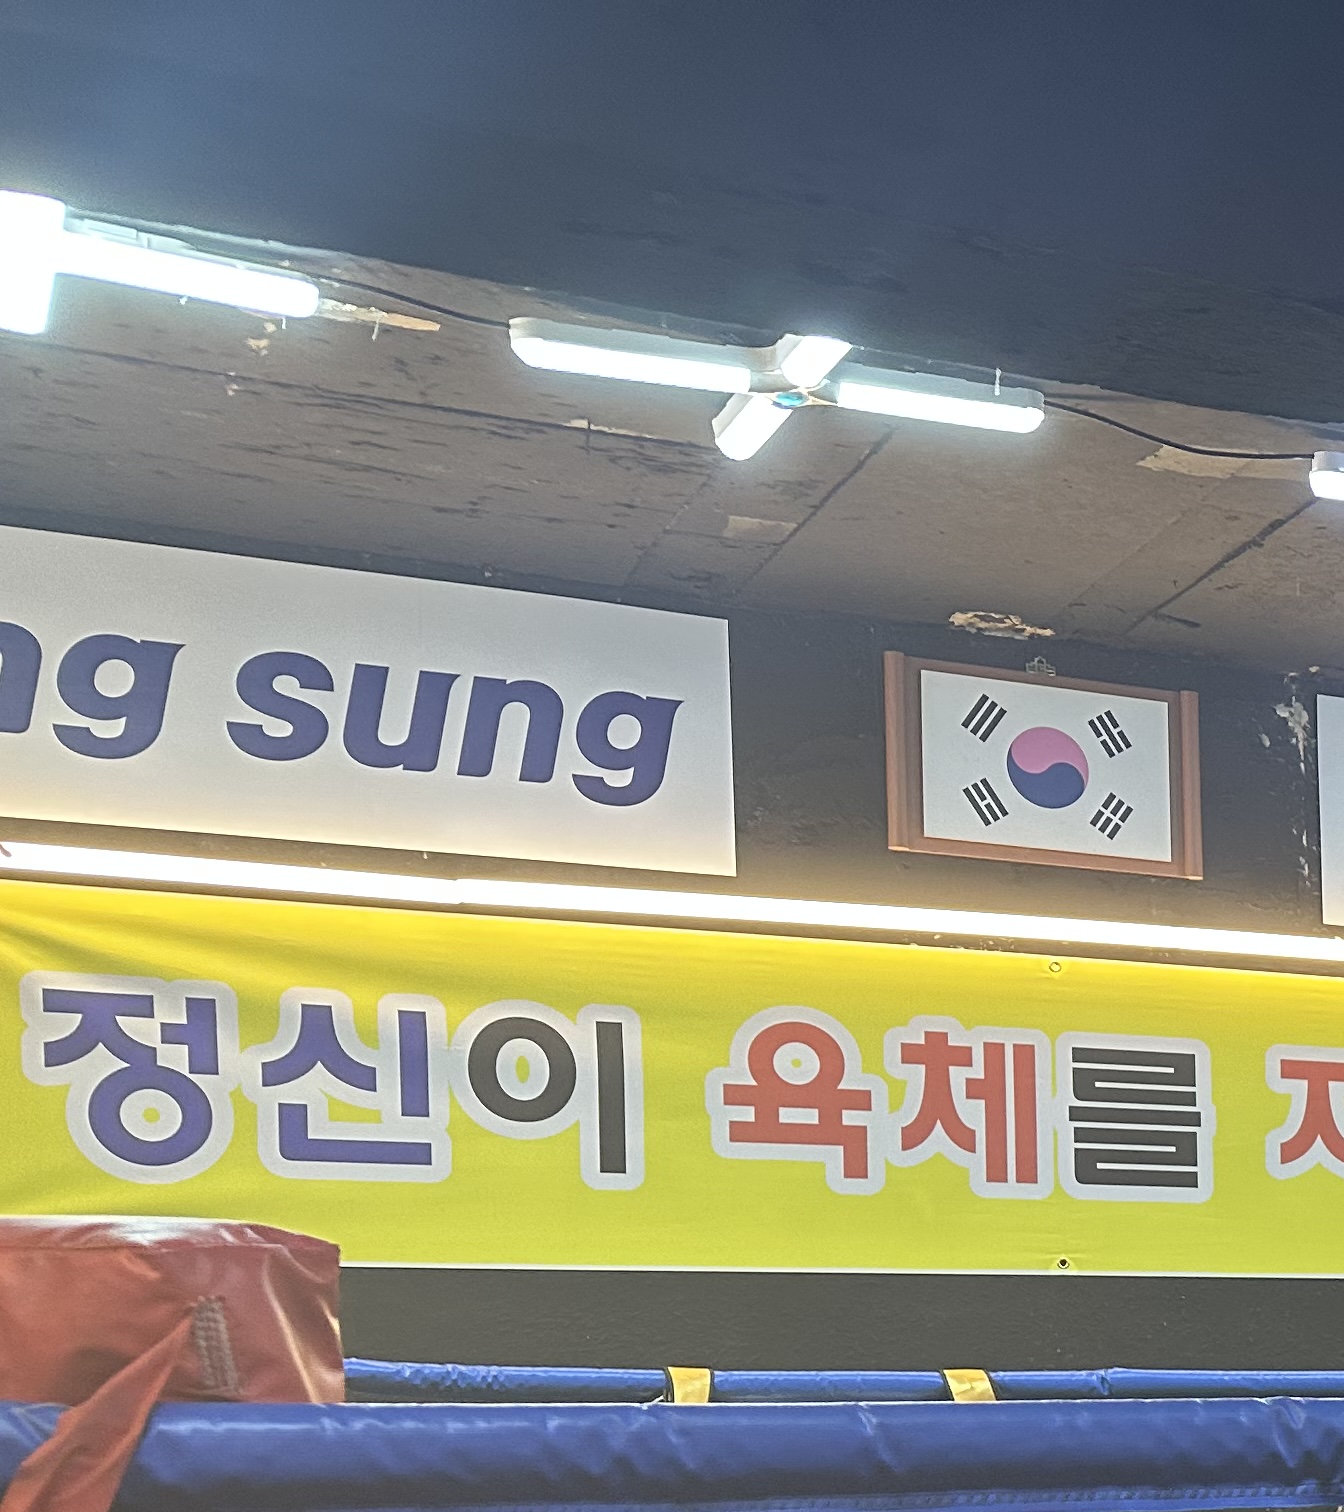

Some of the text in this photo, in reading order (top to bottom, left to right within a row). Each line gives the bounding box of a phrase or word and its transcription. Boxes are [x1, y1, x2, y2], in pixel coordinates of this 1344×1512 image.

[226, 650, 685, 807] sung
[41, 987, 627, 1174] 정신이
[722, 1020, 1201, 1189] 육체를
